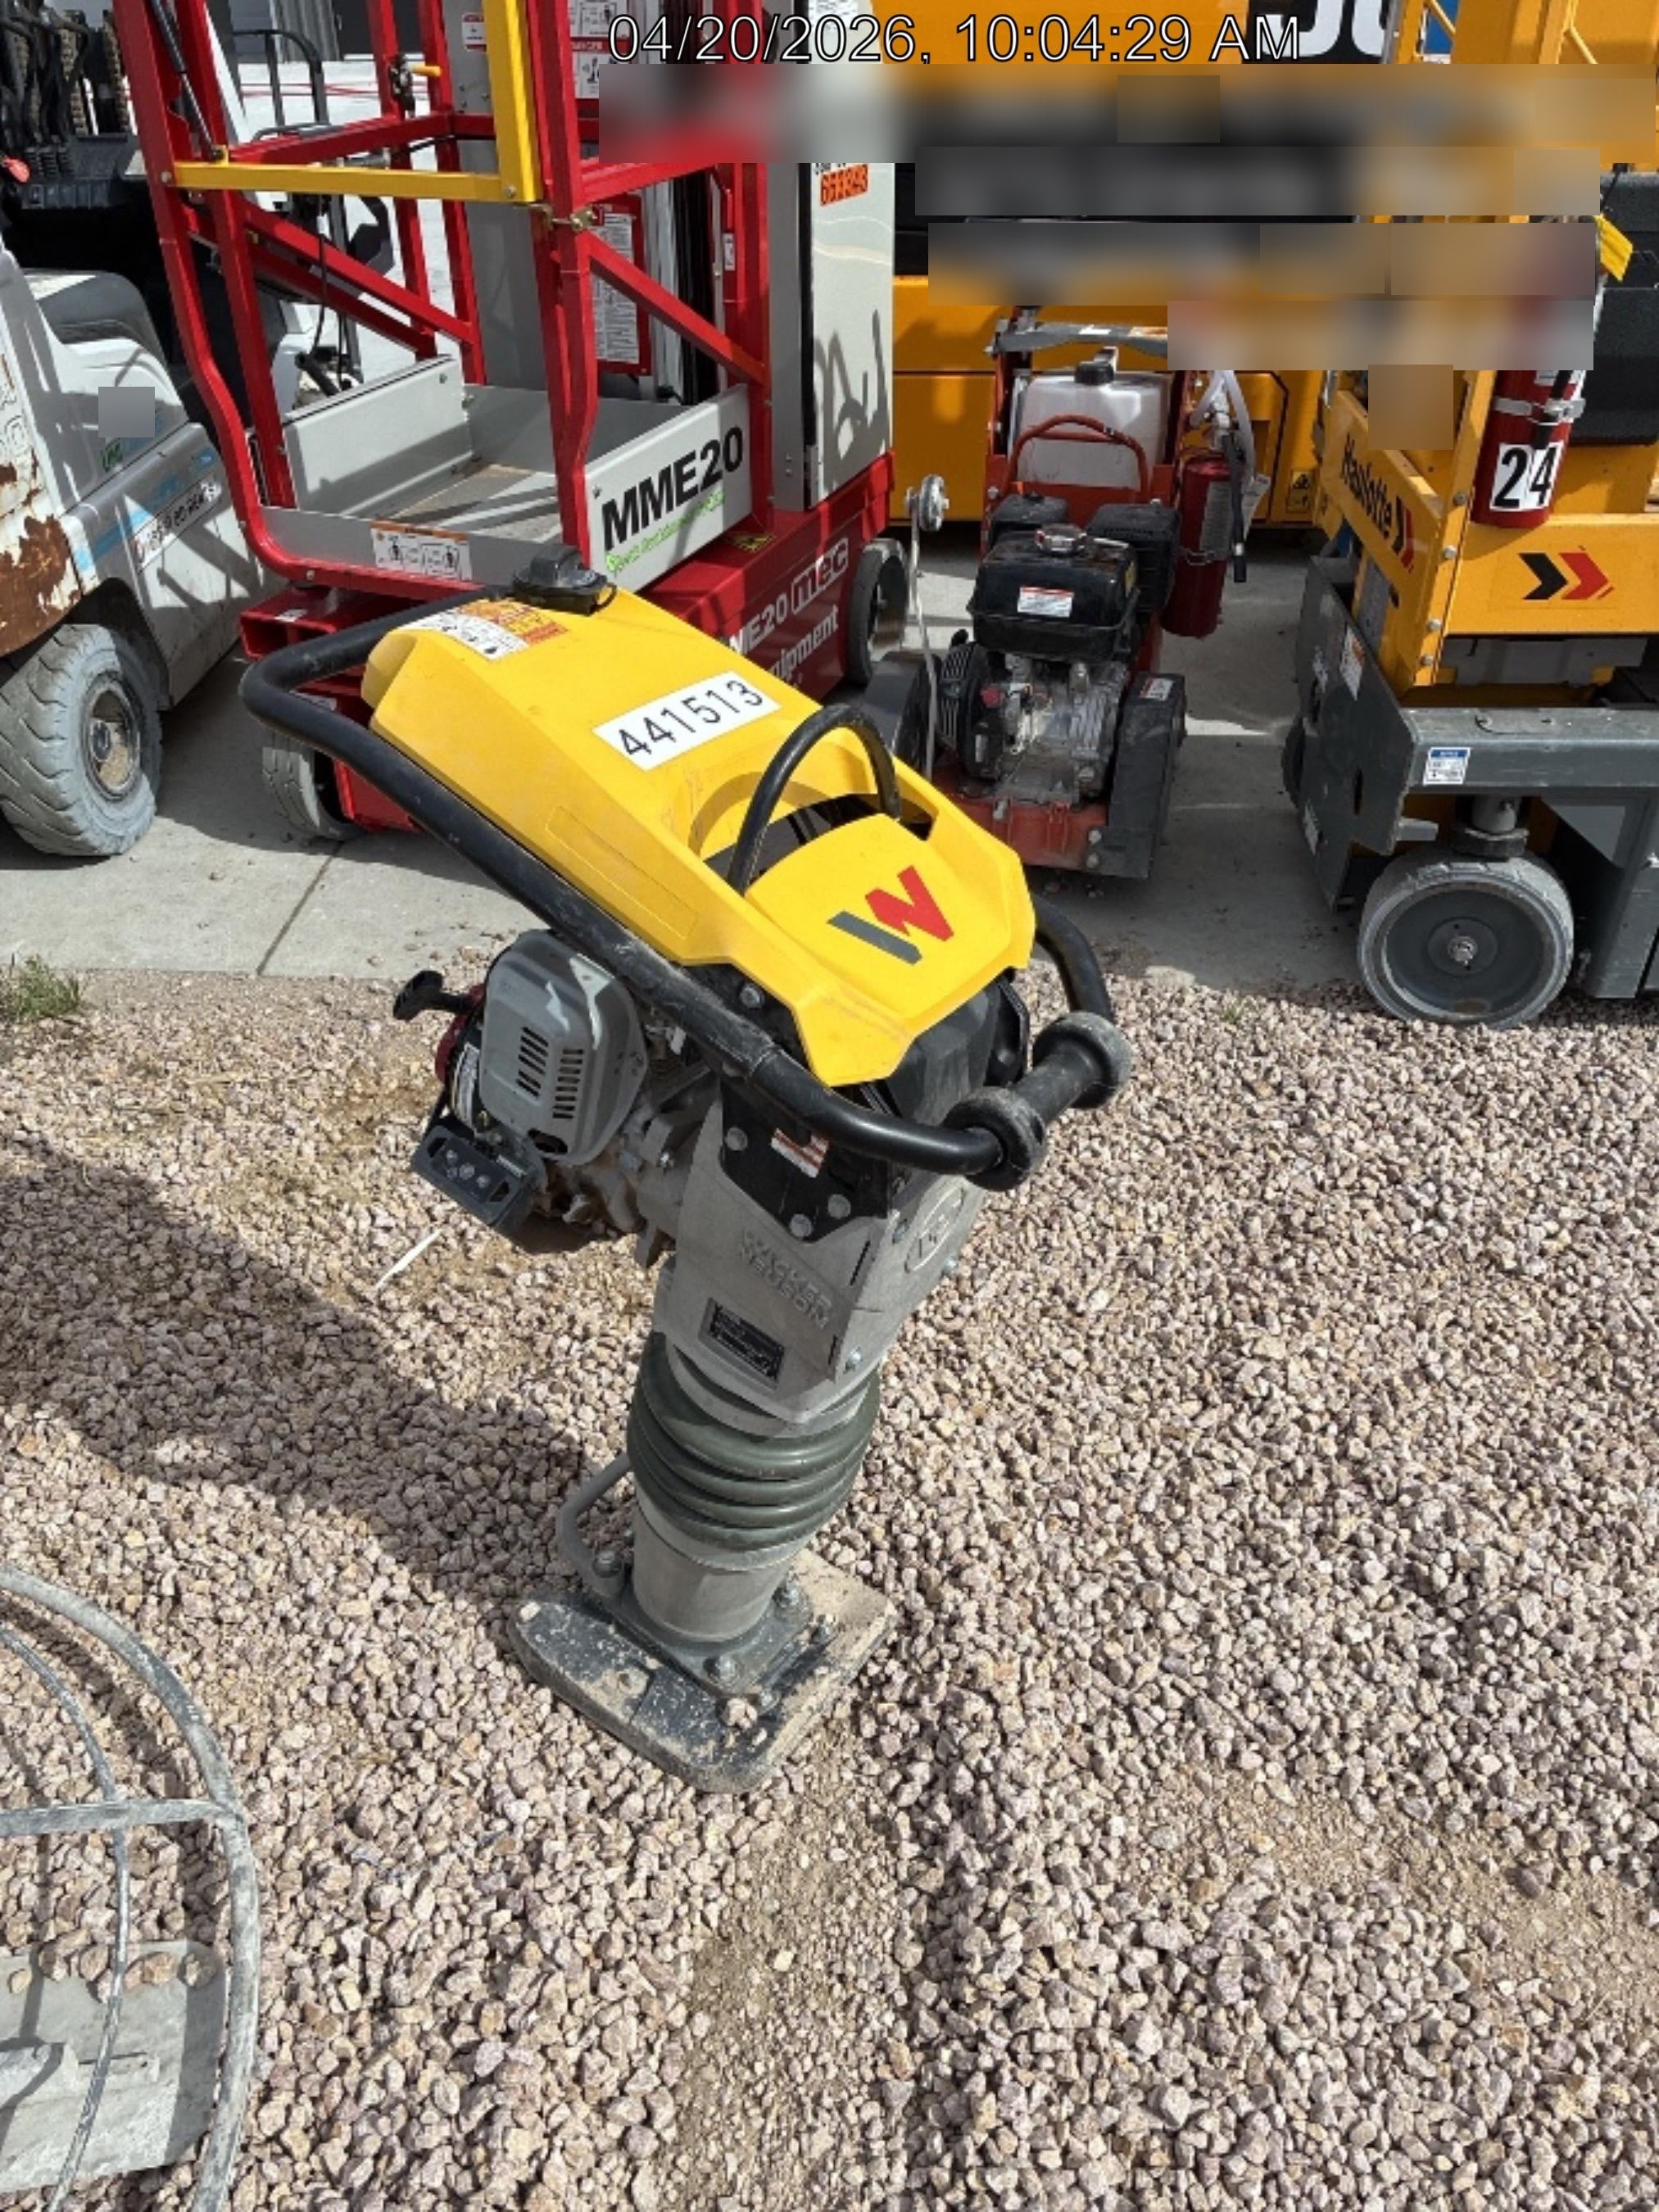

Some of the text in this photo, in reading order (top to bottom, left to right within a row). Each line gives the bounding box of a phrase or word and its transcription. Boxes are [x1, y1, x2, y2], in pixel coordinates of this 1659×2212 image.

[601, 426, 743, 551] MME20
[1494, 446, 1557, 508] 24
[619, 679, 764, 755] 441513
